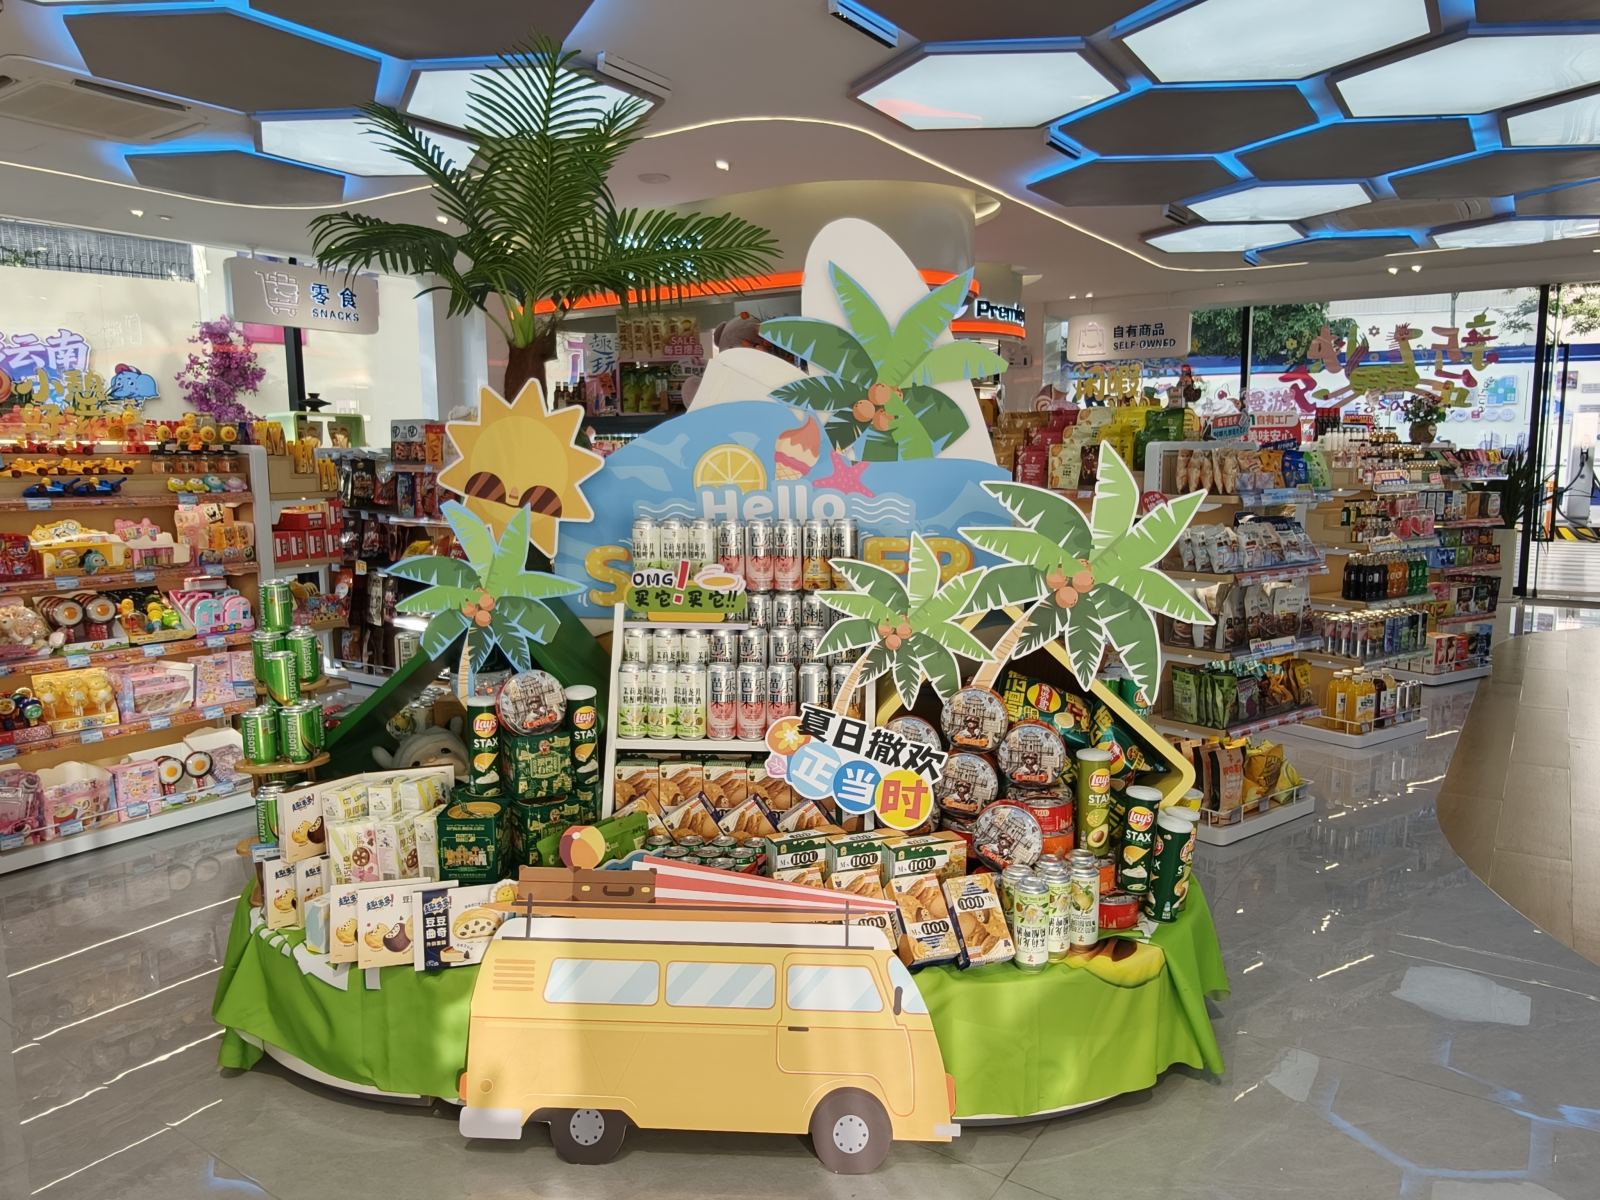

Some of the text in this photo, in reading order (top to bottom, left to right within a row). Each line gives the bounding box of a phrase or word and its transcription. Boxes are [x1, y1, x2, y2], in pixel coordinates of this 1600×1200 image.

[312, 282, 357, 309] 零食
[312, 308, 359, 321] SNACKS
[1113, 322, 1165, 339] 自有商品
[671, 336, 696, 345] SALE
[0, 329, 90, 372] 云南
[702, 485, 846, 522] Hello
[304, 637, 314, 679] Watson's
[475, 717, 497, 731] Lay's
[244, 720, 256, 759] Watson's
[288, 716, 299, 757] Watson's
[473, 737, 499, 748] STAX
[797, 705, 946, 781] 夏日撒欢
[791, 746, 929, 820] 正当时
[257, 800, 266, 842] Watson's
[1129, 811, 1153, 826] Lay's
[1126, 830, 1152, 842] STAX
[791, 850, 818, 866] HOU
[850, 852, 878, 868] HOU
[907, 857, 936, 872] HOU
[921, 920, 949, 935] HOU
